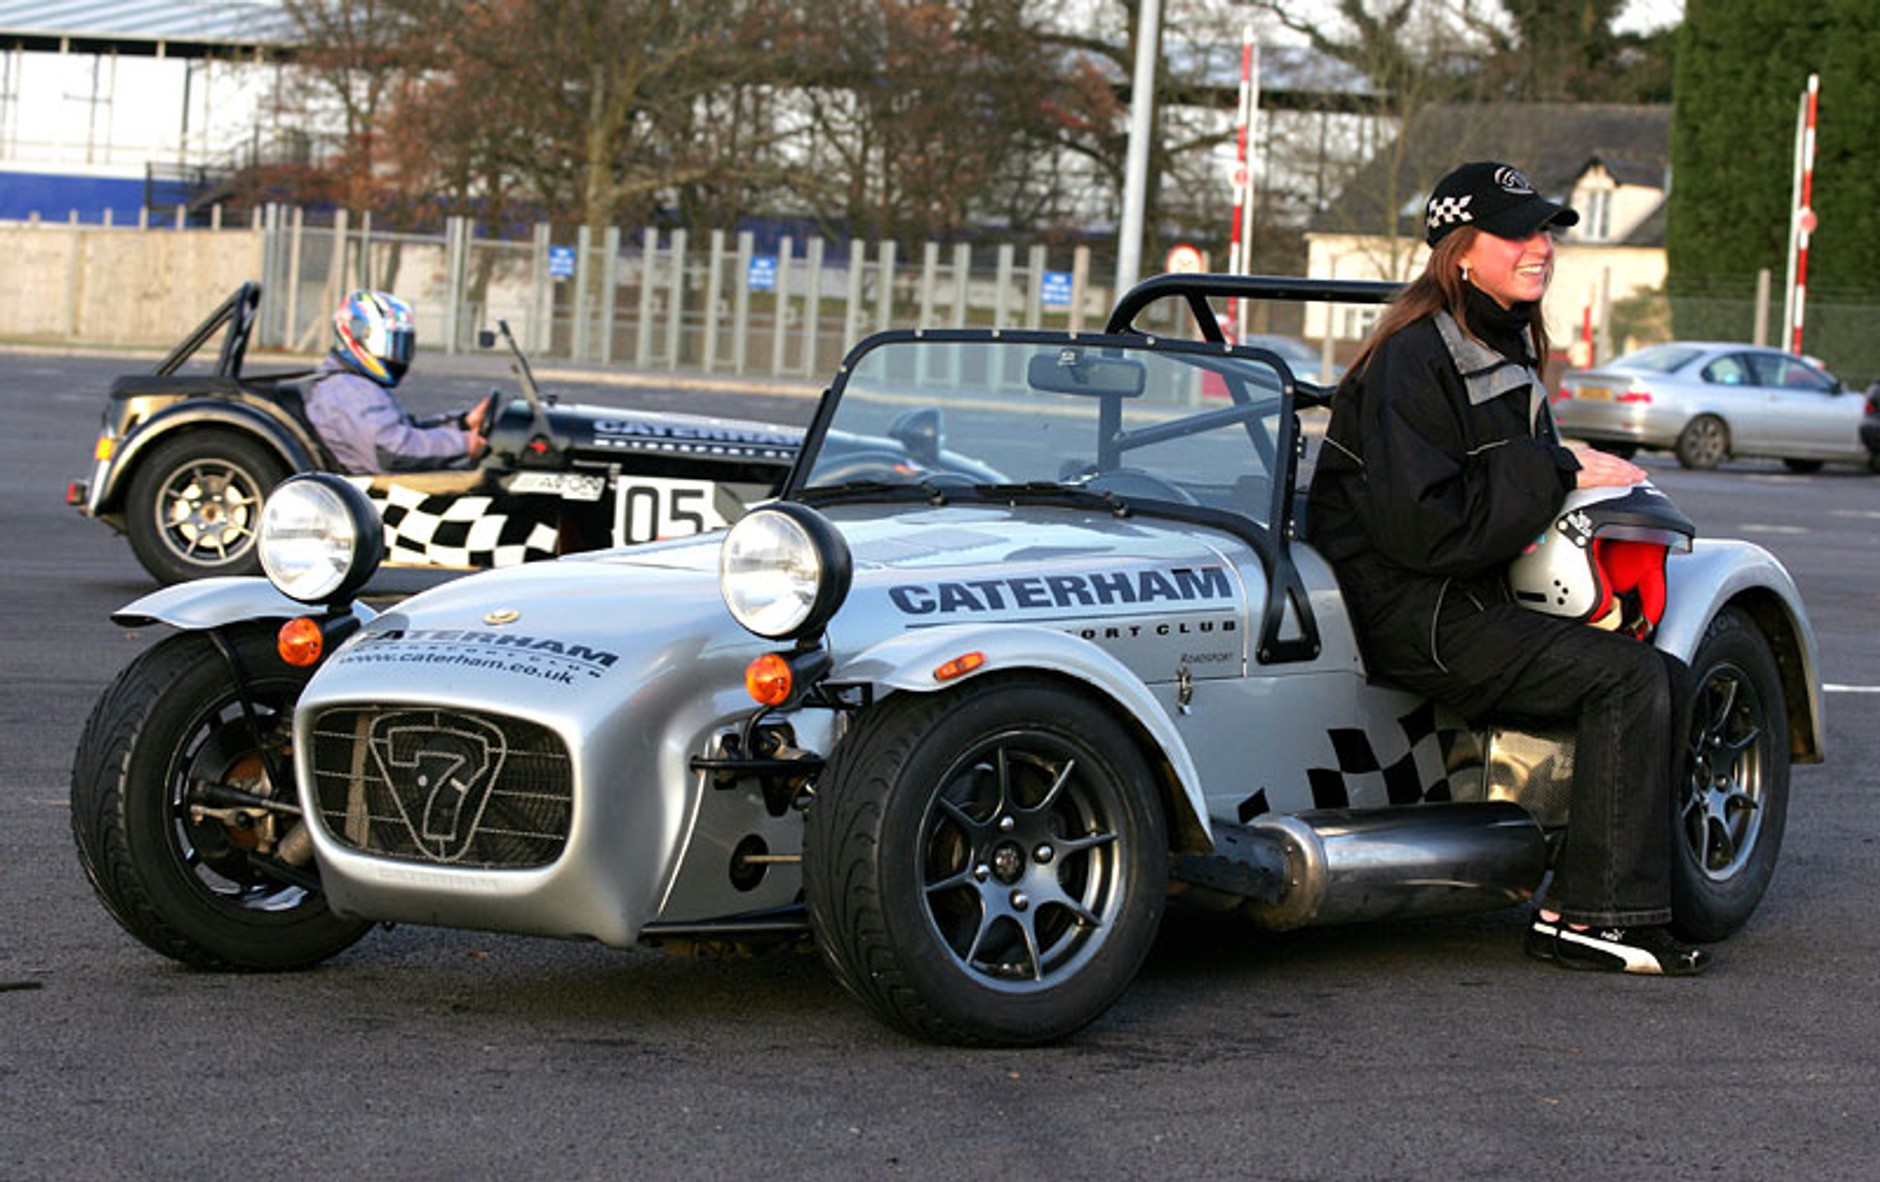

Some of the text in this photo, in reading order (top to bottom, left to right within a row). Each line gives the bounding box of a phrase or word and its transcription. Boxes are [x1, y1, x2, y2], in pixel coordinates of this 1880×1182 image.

[625, 486, 704, 546] 05
[889, 567, 1233, 614] CATERHAM
[1156, 620, 1236, 636] CLUB
[339, 652, 575, 685] www.caterham.co.uk
[388, 725, 489, 841] 7
